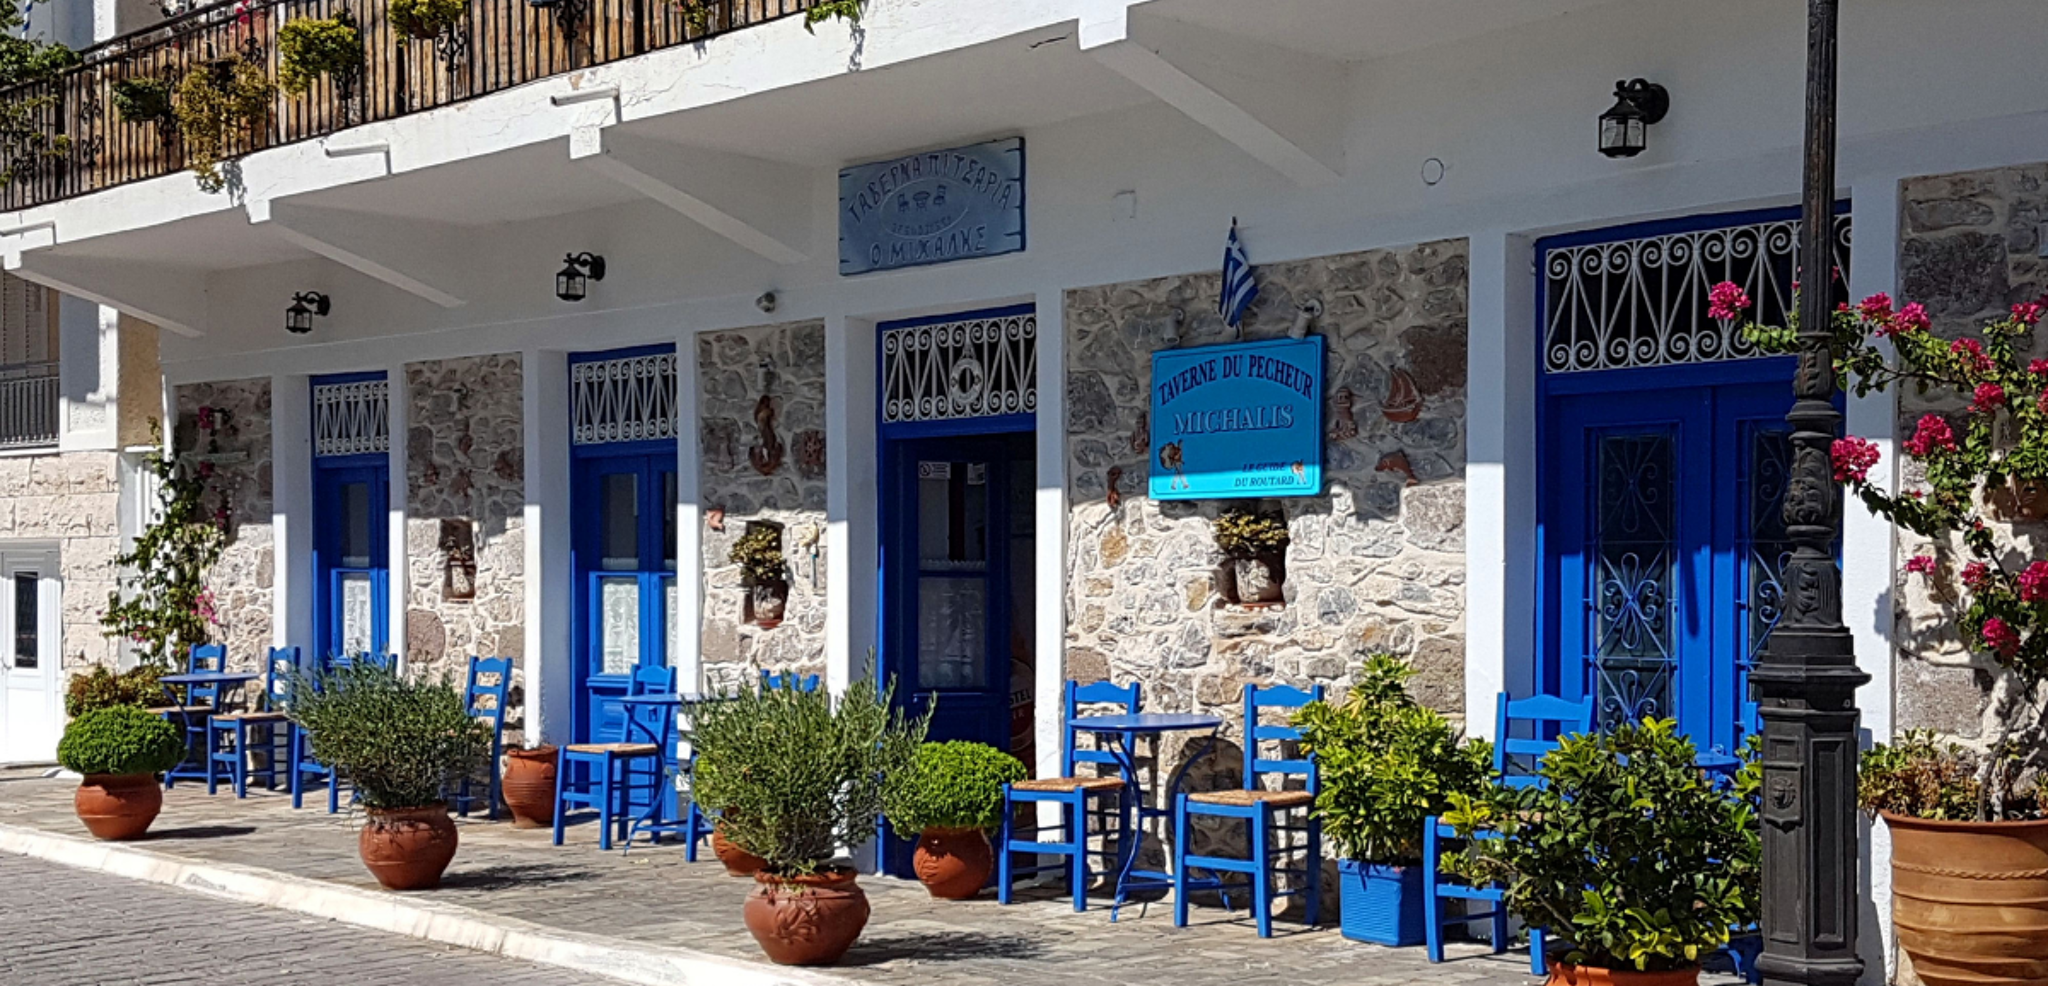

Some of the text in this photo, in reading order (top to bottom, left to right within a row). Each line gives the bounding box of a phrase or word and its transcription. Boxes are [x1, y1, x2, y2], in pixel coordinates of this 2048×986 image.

[928, 153, 1012, 211] ΠΙΤΣΑΡΙΑ
[870, 226, 987, 266] Ο ΜΙΧΑΛΗΣ
[1158, 354, 1314, 406] TAVERNE DU PECHEUR
[1174, 404, 1294, 435] MICHALIS
[1234, 476, 1295, 487] DU ROUTARD
[1256, 462, 1286, 472] GUIDE
[1008, 688, 1031, 704] STEL
